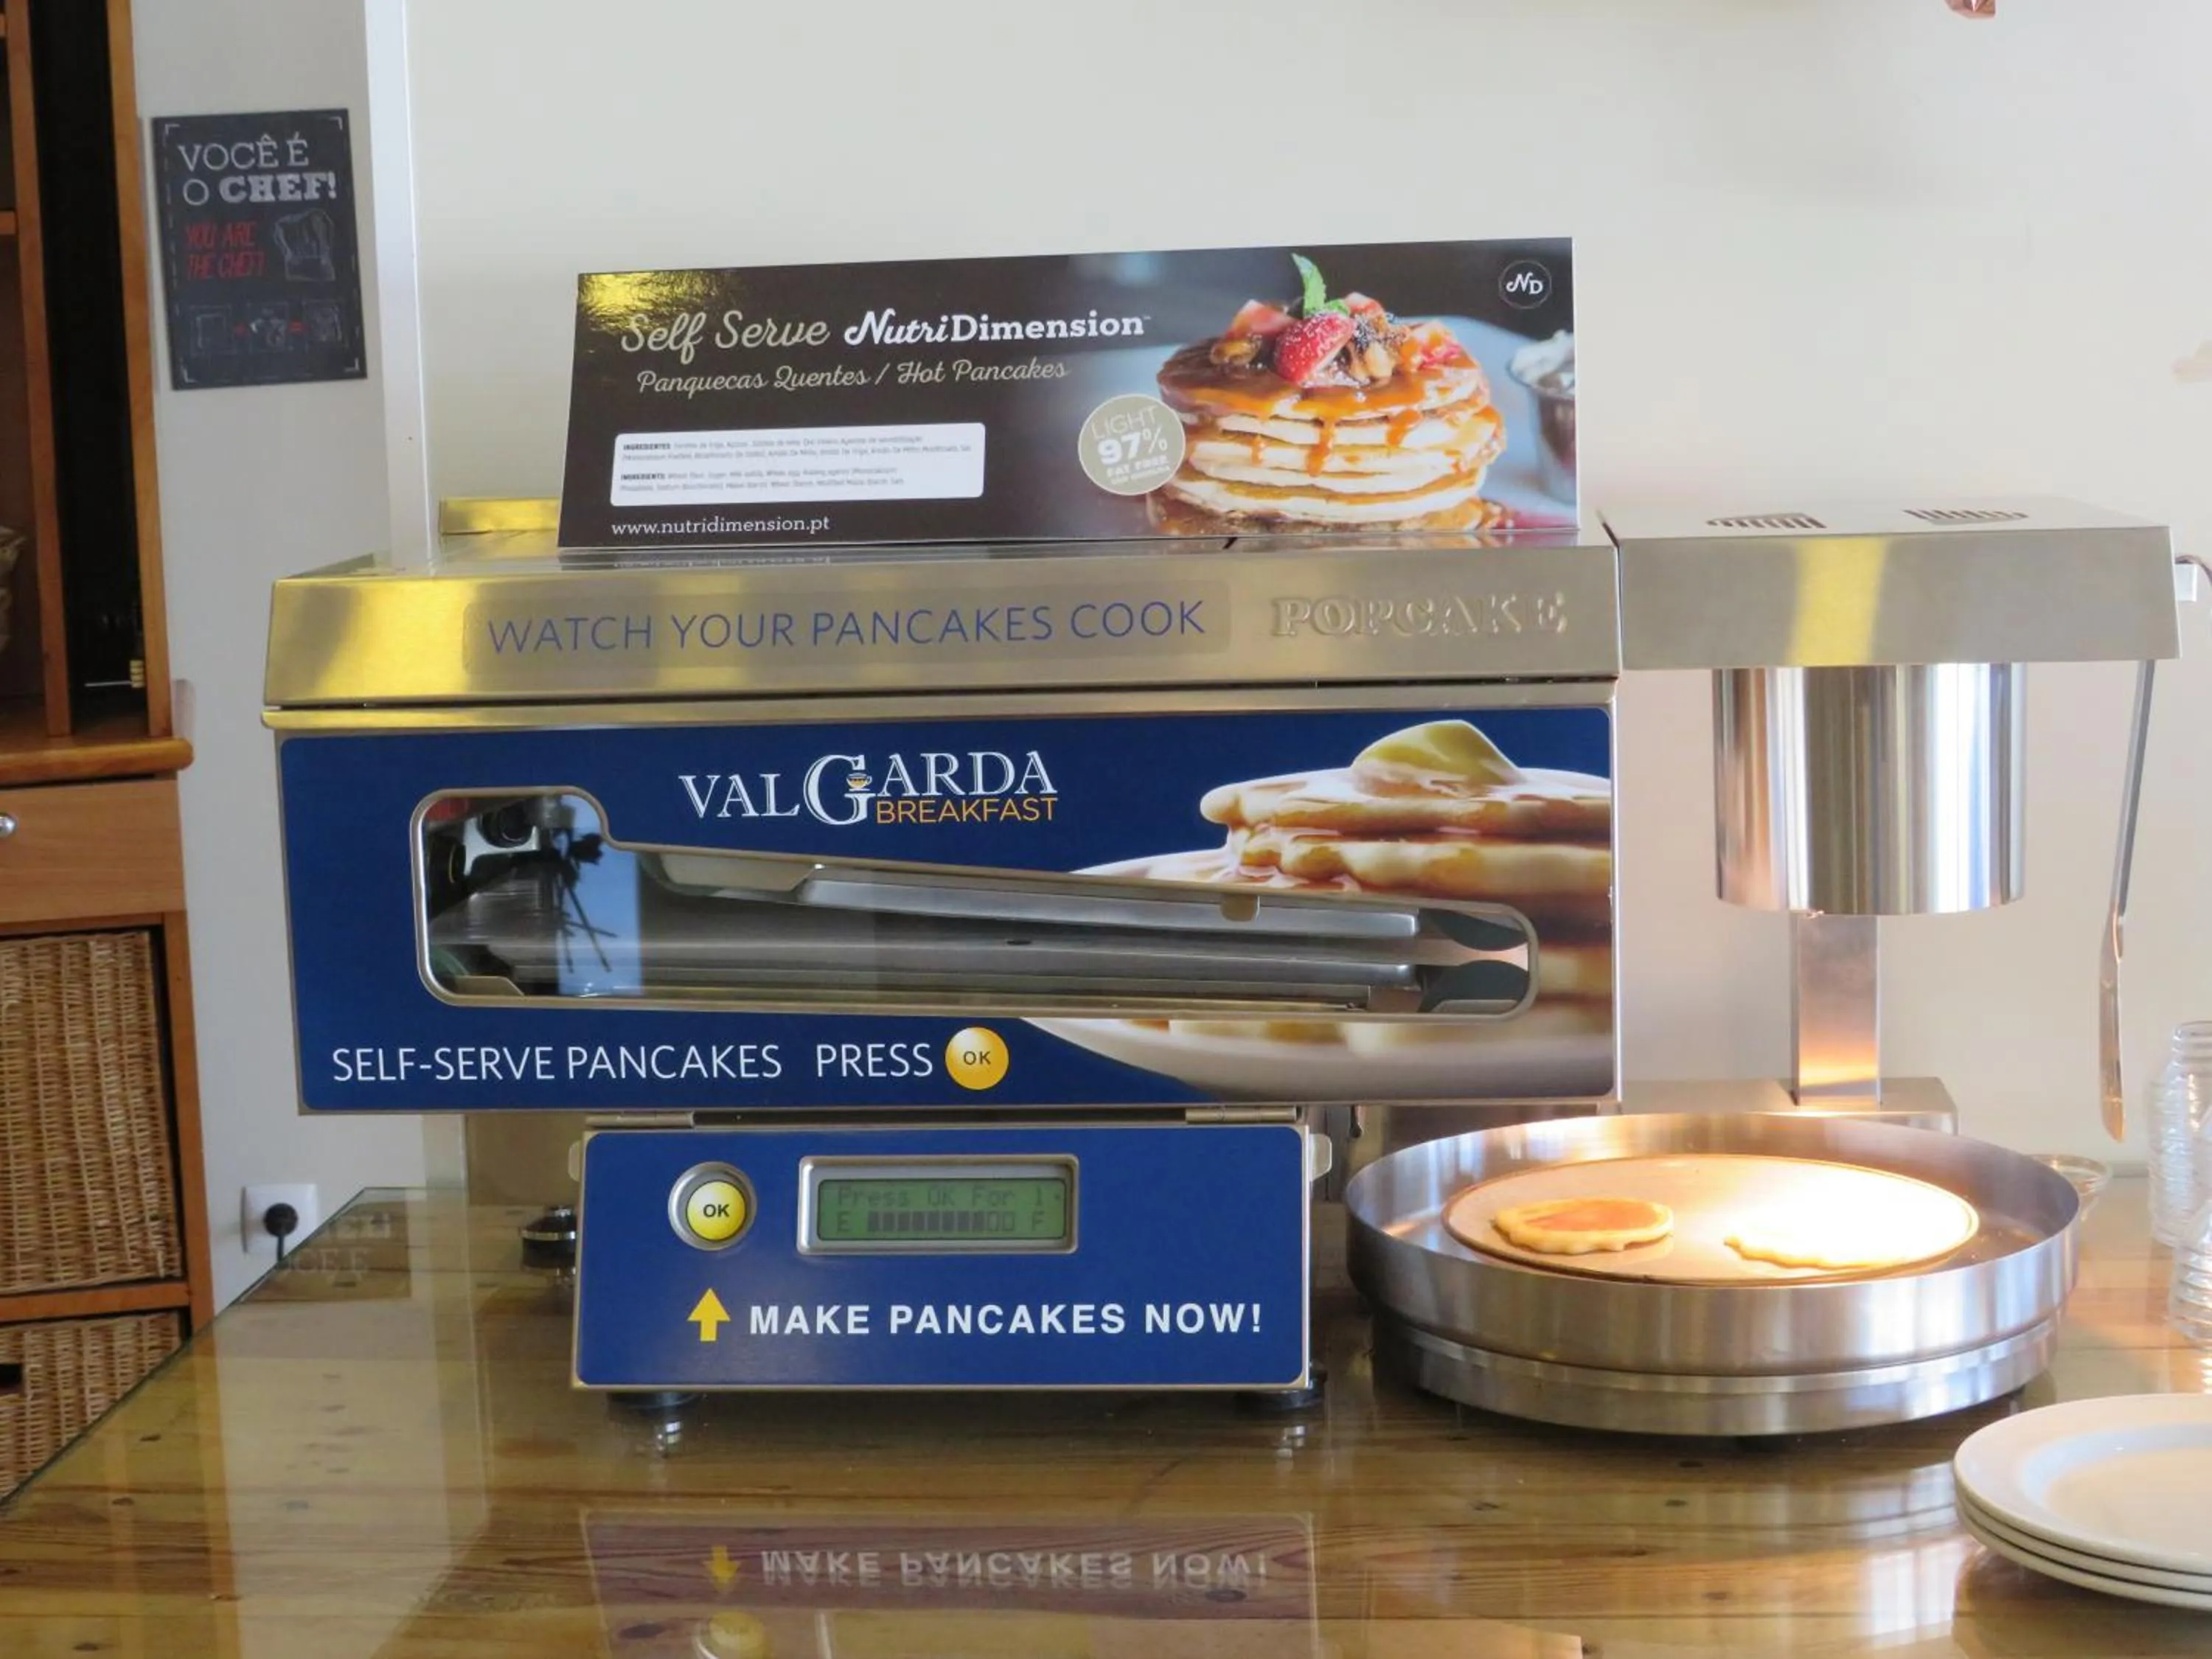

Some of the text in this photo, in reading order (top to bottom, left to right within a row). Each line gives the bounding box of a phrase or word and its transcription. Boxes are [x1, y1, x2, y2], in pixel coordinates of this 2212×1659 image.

[178, 131, 309, 172] VOCÊ É
[183, 171, 336, 206] O CHEF!
[621, 312, 706, 364] Self
[715, 310, 831, 349] Serve
[637, 356, 1072, 399] Panquecas Quentes / Hot Pancakes
[1091, 406, 1158, 440] LIGHT
[1098, 425, 1168, 465] 97%
[611, 516, 830, 536] www.nutridimension.pt
[487, 599, 1206, 653] WATCH YOUR PANCAKES COOK
[1271, 591, 1569, 638] POPCAKE
[877, 797, 1058, 824] BREAKFAST
[332, 1042, 992, 1082] SELF-SERVE PANCAKES PRESS OK
[703, 1203, 730, 1218] OK
[838, 1187, 910, 1206] Press
[927, 1187, 956, 1206] OK
[972, 1186, 1015, 1206] For
[749, 1303, 1262, 1335] MAKE PANCAKES NOW!
